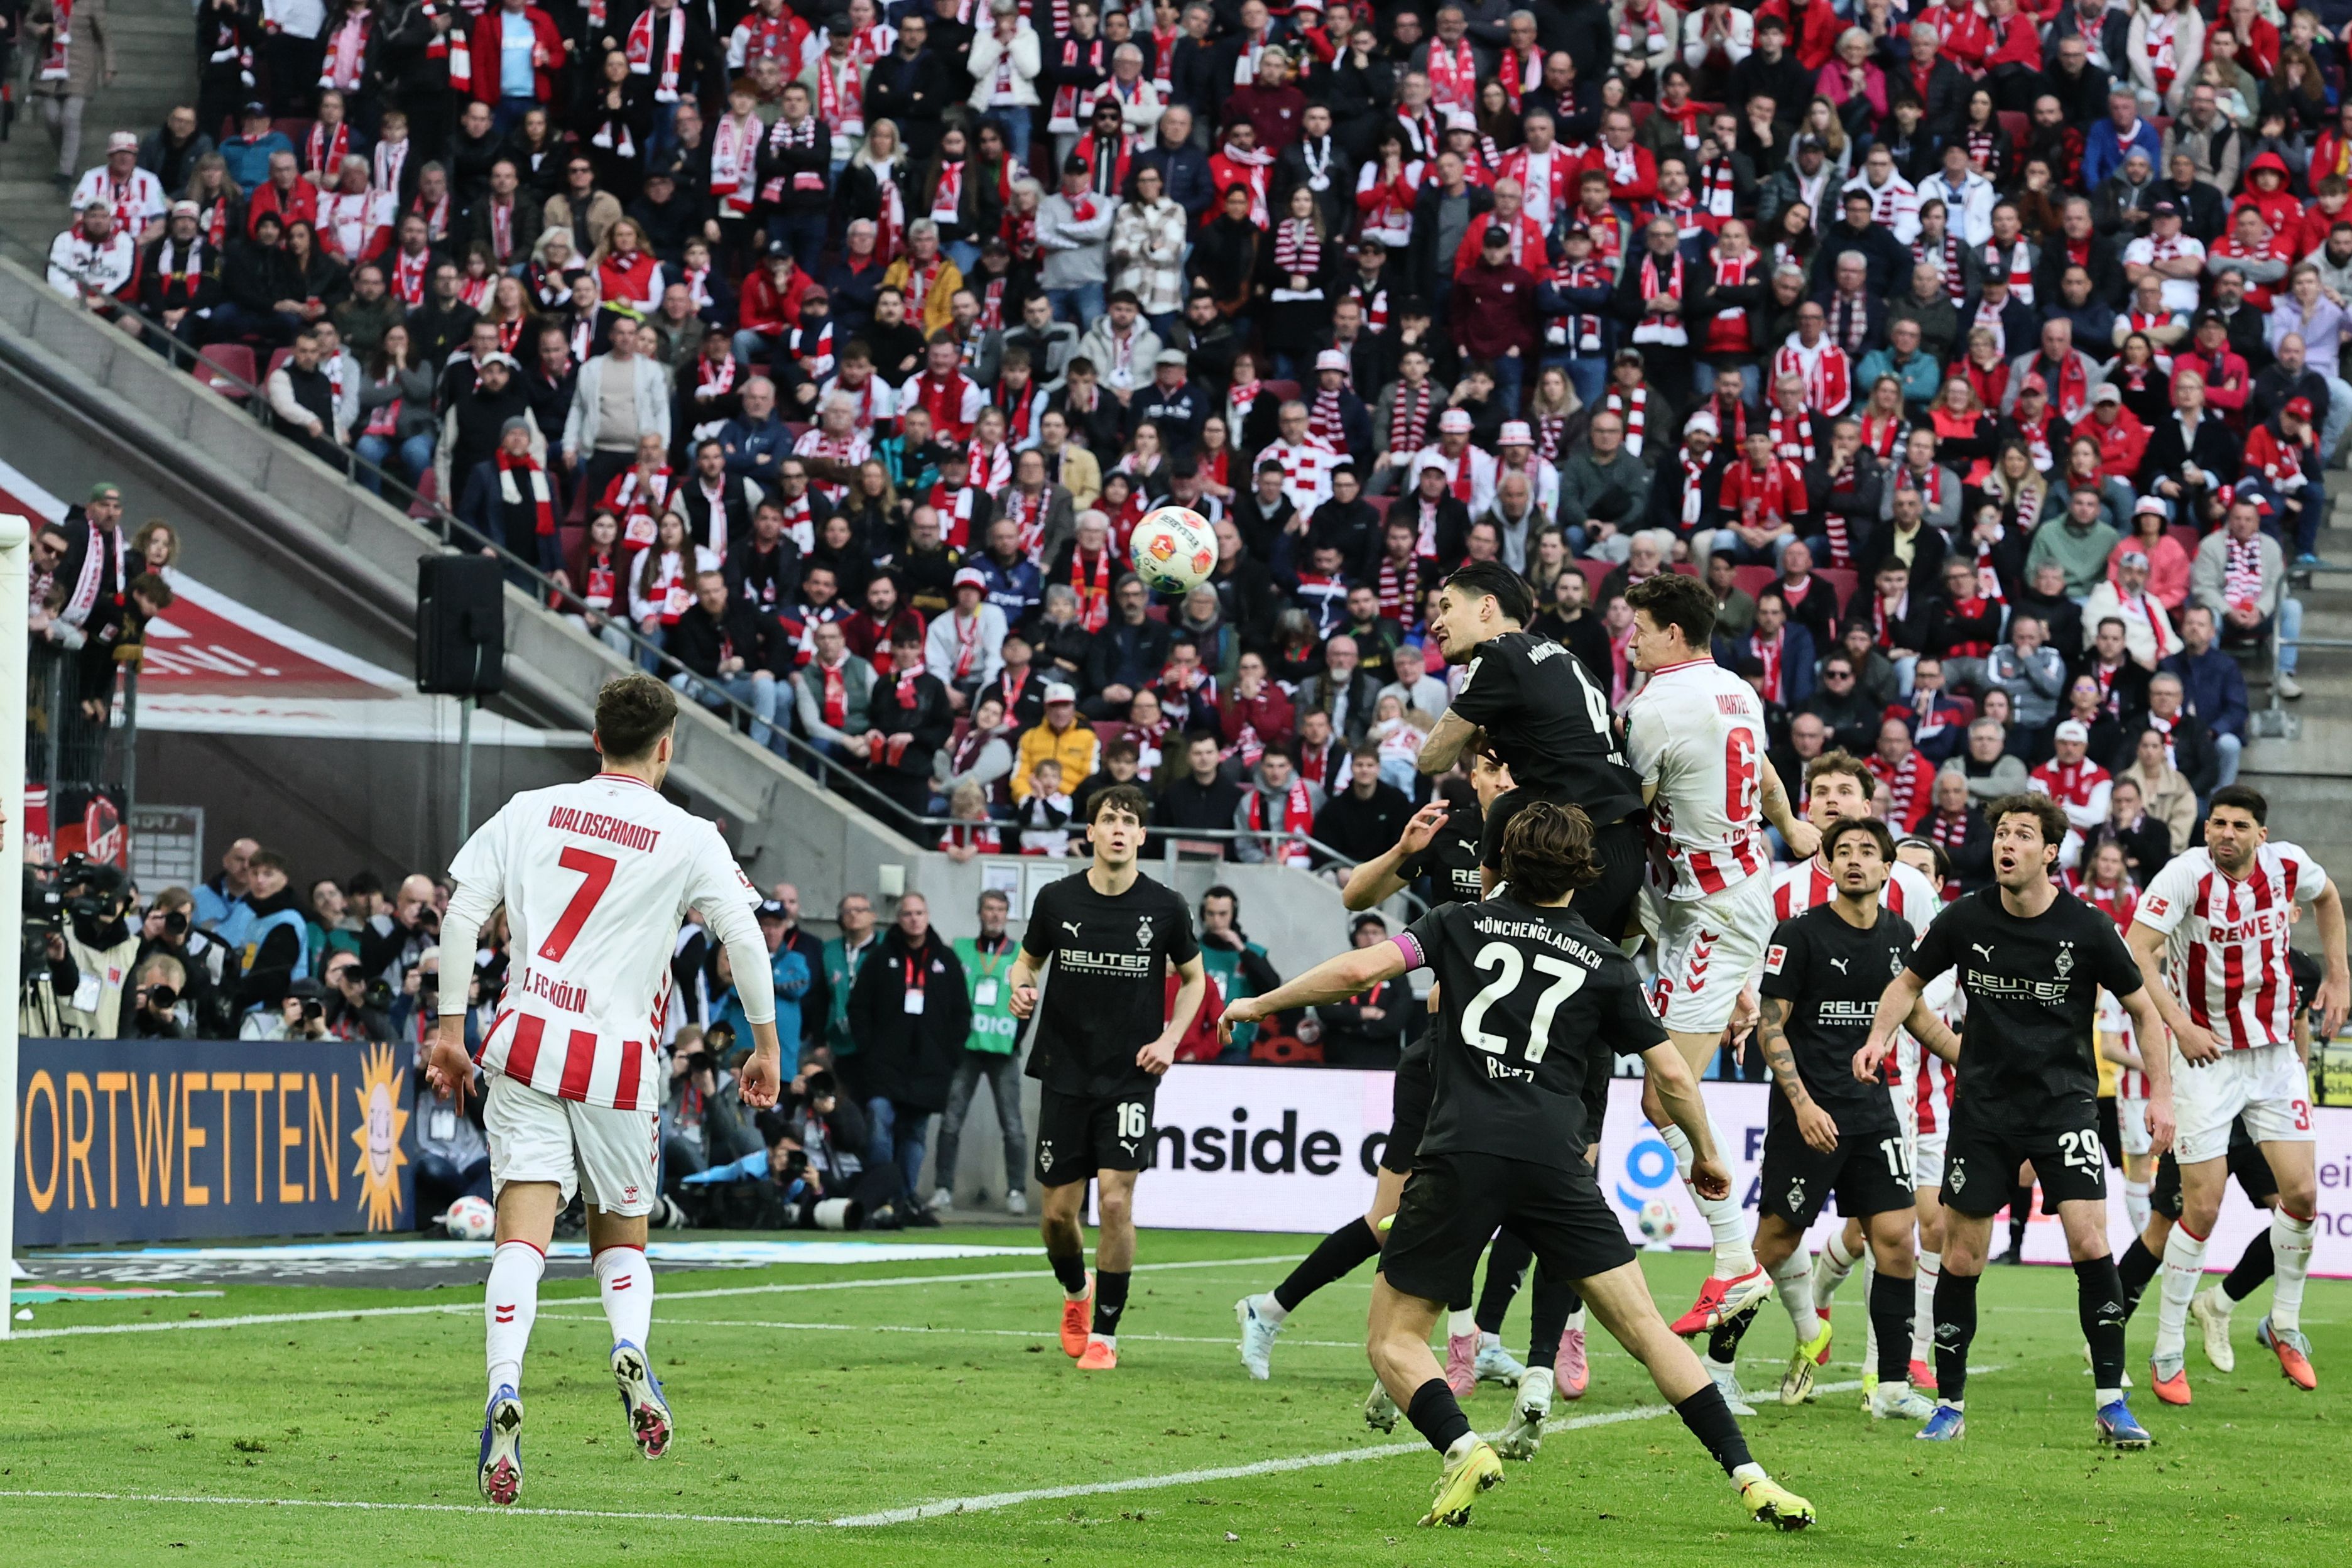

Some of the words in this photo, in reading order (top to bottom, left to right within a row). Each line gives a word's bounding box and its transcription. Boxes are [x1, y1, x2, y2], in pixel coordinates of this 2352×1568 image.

[1572, 660, 1614, 750] 4
[1716, 695, 1750, 714] MARTEL
[1726, 727, 1758, 822] 6
[548, 805, 661, 853] WALDSCHMIDT
[538, 846, 617, 963] 7
[1474, 917, 1603, 969] MÖNCHENGLADBACH
[2209, 915, 2272, 943] REWE
[1060, 948, 1151, 968] REUTER
[523, 967, 531, 992] 1.
[533, 972, 549, 999] FC
[550, 980, 587, 1013] KÖLN
[1461, 942, 1587, 1064] 27
[1655, 978, 1674, 1017] 6
[1968, 969, 2070, 996] REUTER
[1819, 1001, 1880, 1014] REUT
[15, 1069, 339, 1212] ORTWETTEN
[1116, 1102, 1146, 1138] 16
[1148, 1107, 1341, 1177] nside
[1880, 1136, 1910, 1176] 17
[2058, 1129, 2101, 1167] 29
